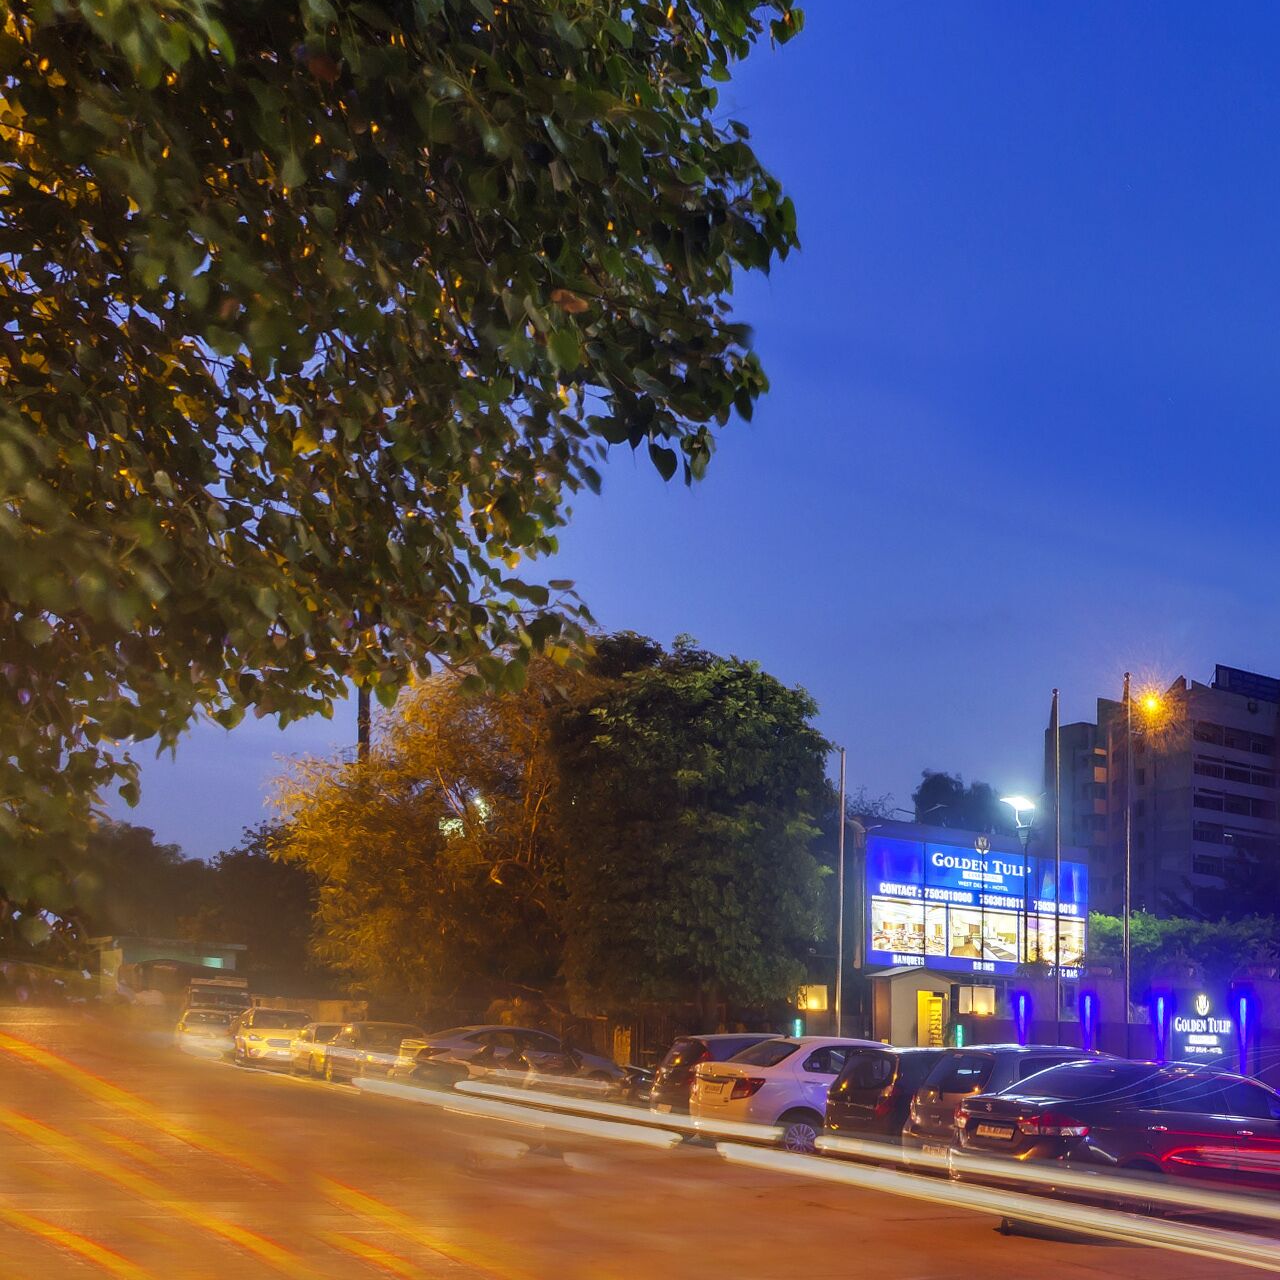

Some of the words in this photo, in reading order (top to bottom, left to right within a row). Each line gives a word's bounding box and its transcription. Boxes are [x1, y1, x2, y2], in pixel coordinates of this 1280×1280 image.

[932, 853, 988, 871] GOLDEN
[892, 954, 925, 966] BANQUETS
[1174, 1017, 1207, 1032] GOLDEN
[1208, 1017, 1231, 1033] TULIP
